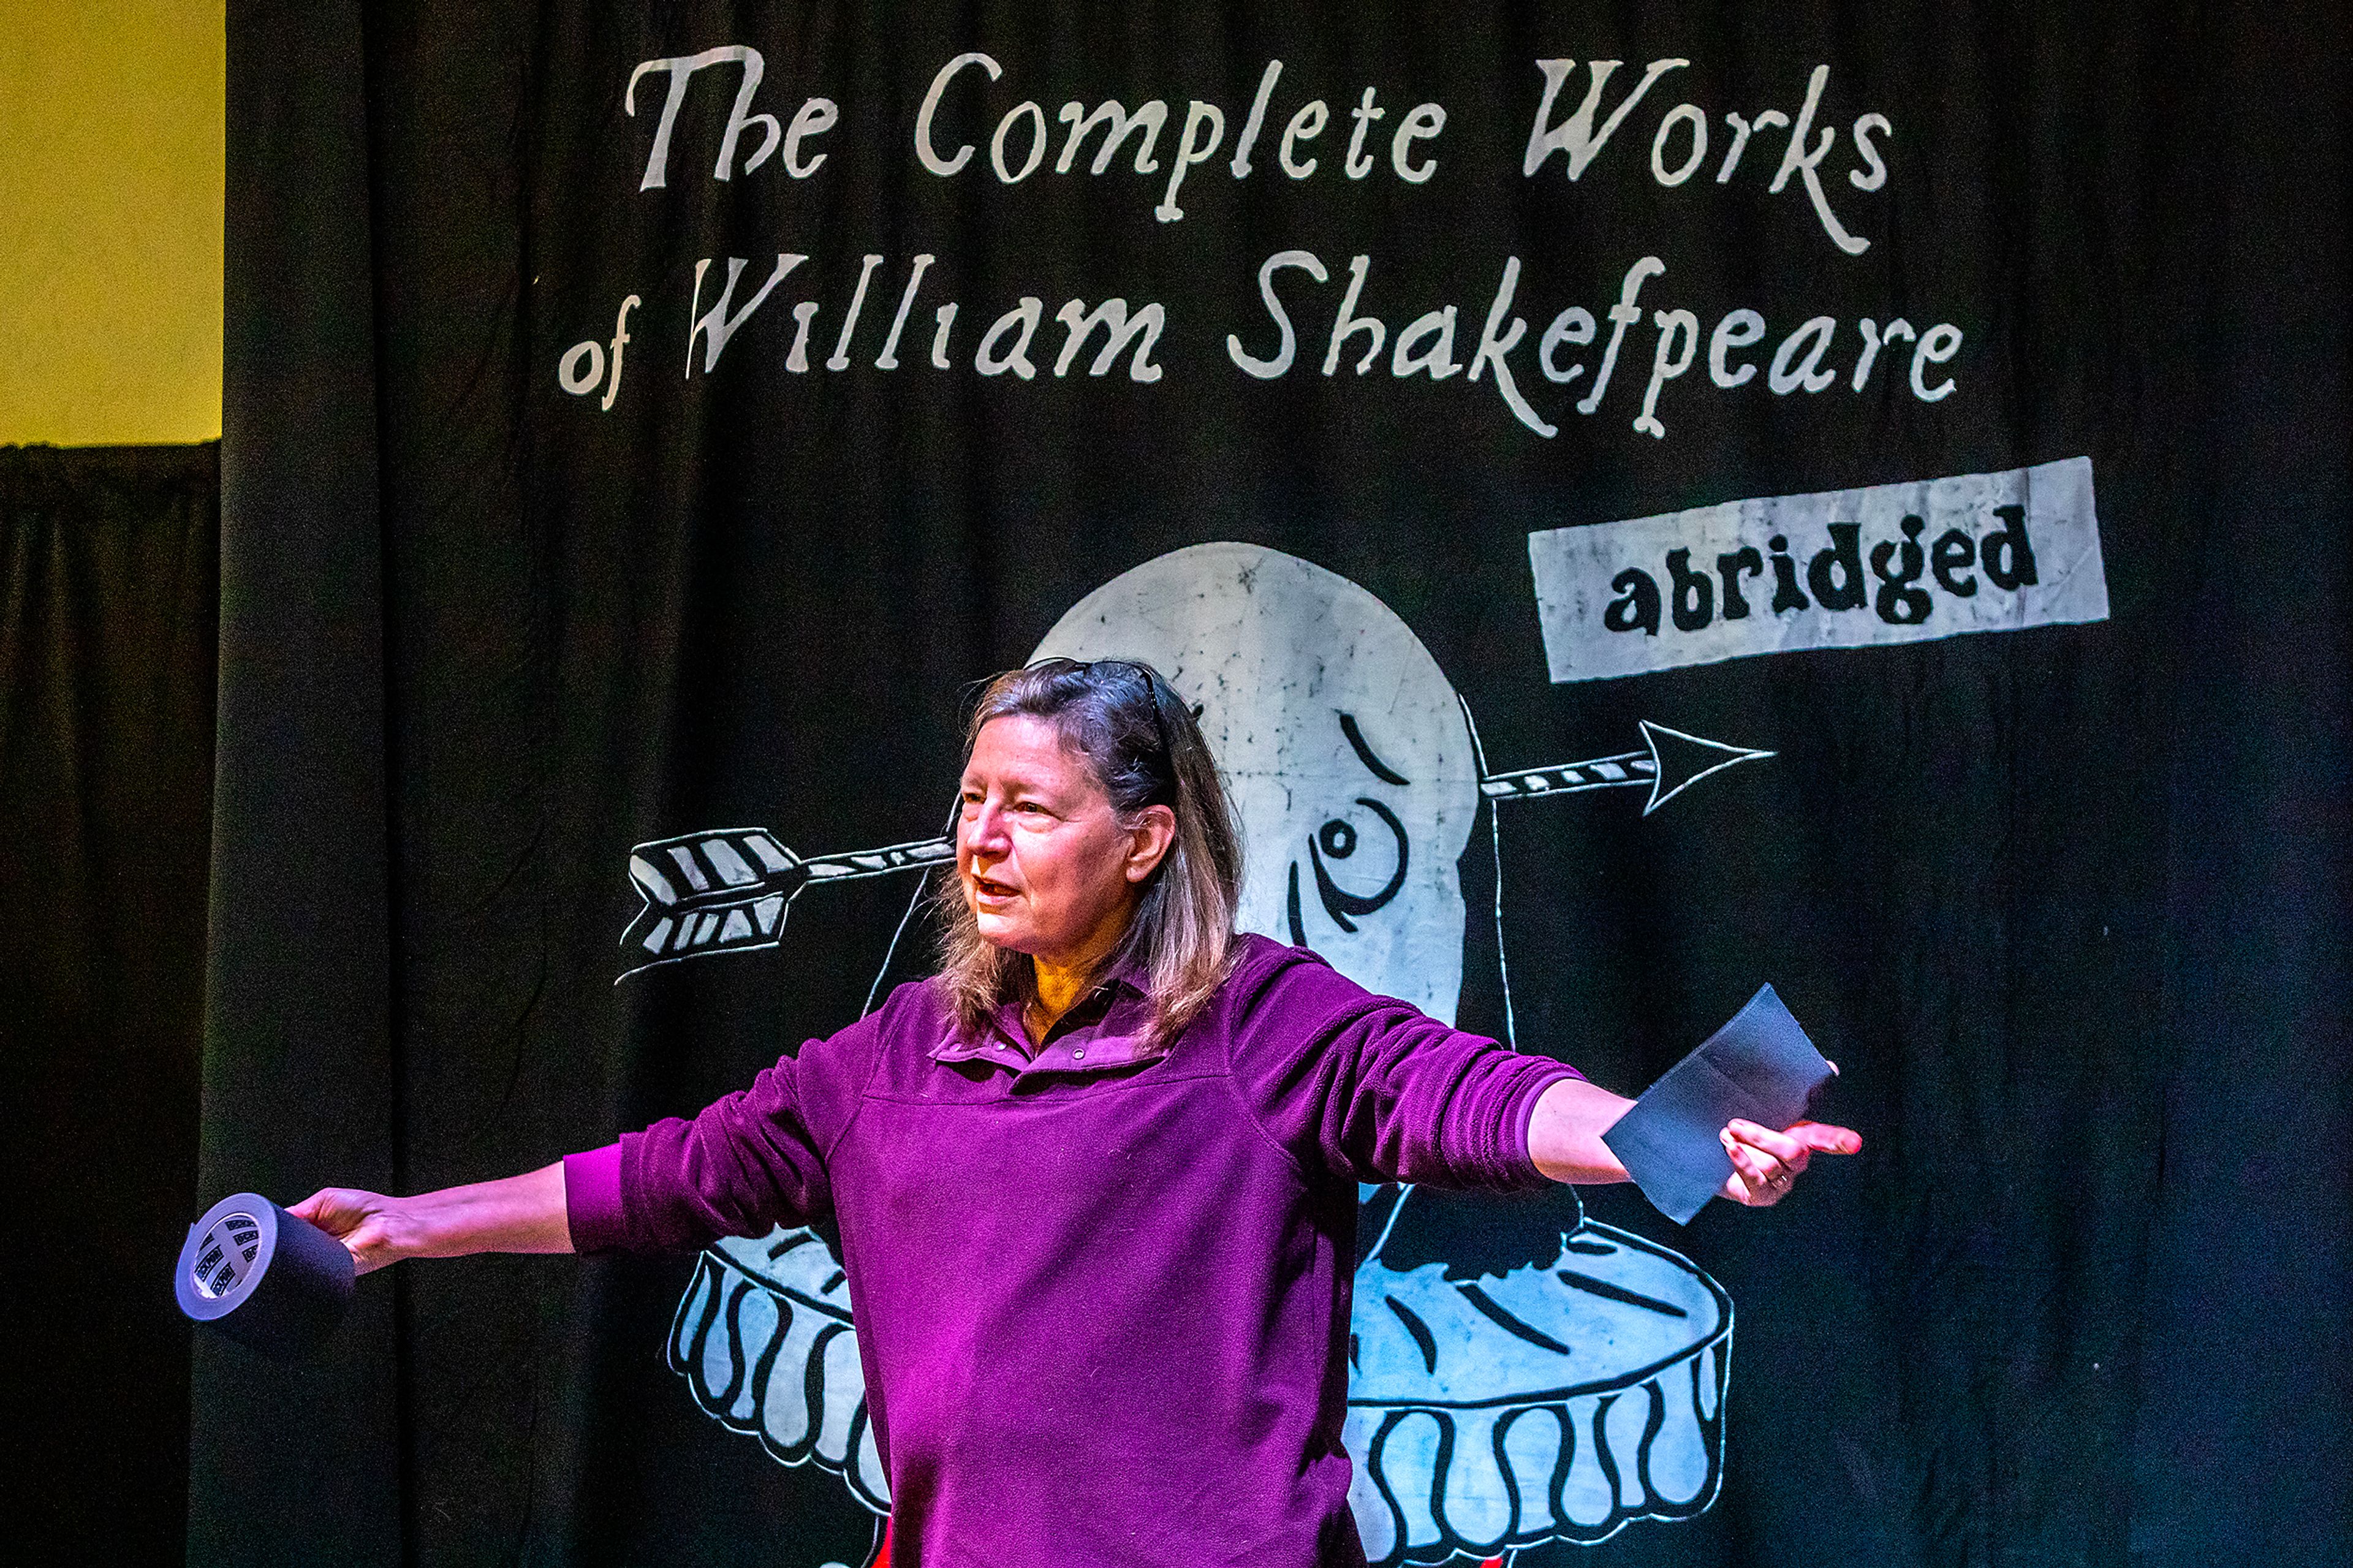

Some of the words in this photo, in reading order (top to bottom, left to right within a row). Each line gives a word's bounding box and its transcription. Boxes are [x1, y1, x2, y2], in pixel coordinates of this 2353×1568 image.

[624, 44, 839, 192] The
[914, 52, 1448, 224] Complete
[1522, 58, 1893, 256] Works
[558, 294, 642, 412] of
[685, 252, 1166, 384] William
[1603, 503, 2039, 637] abridged
